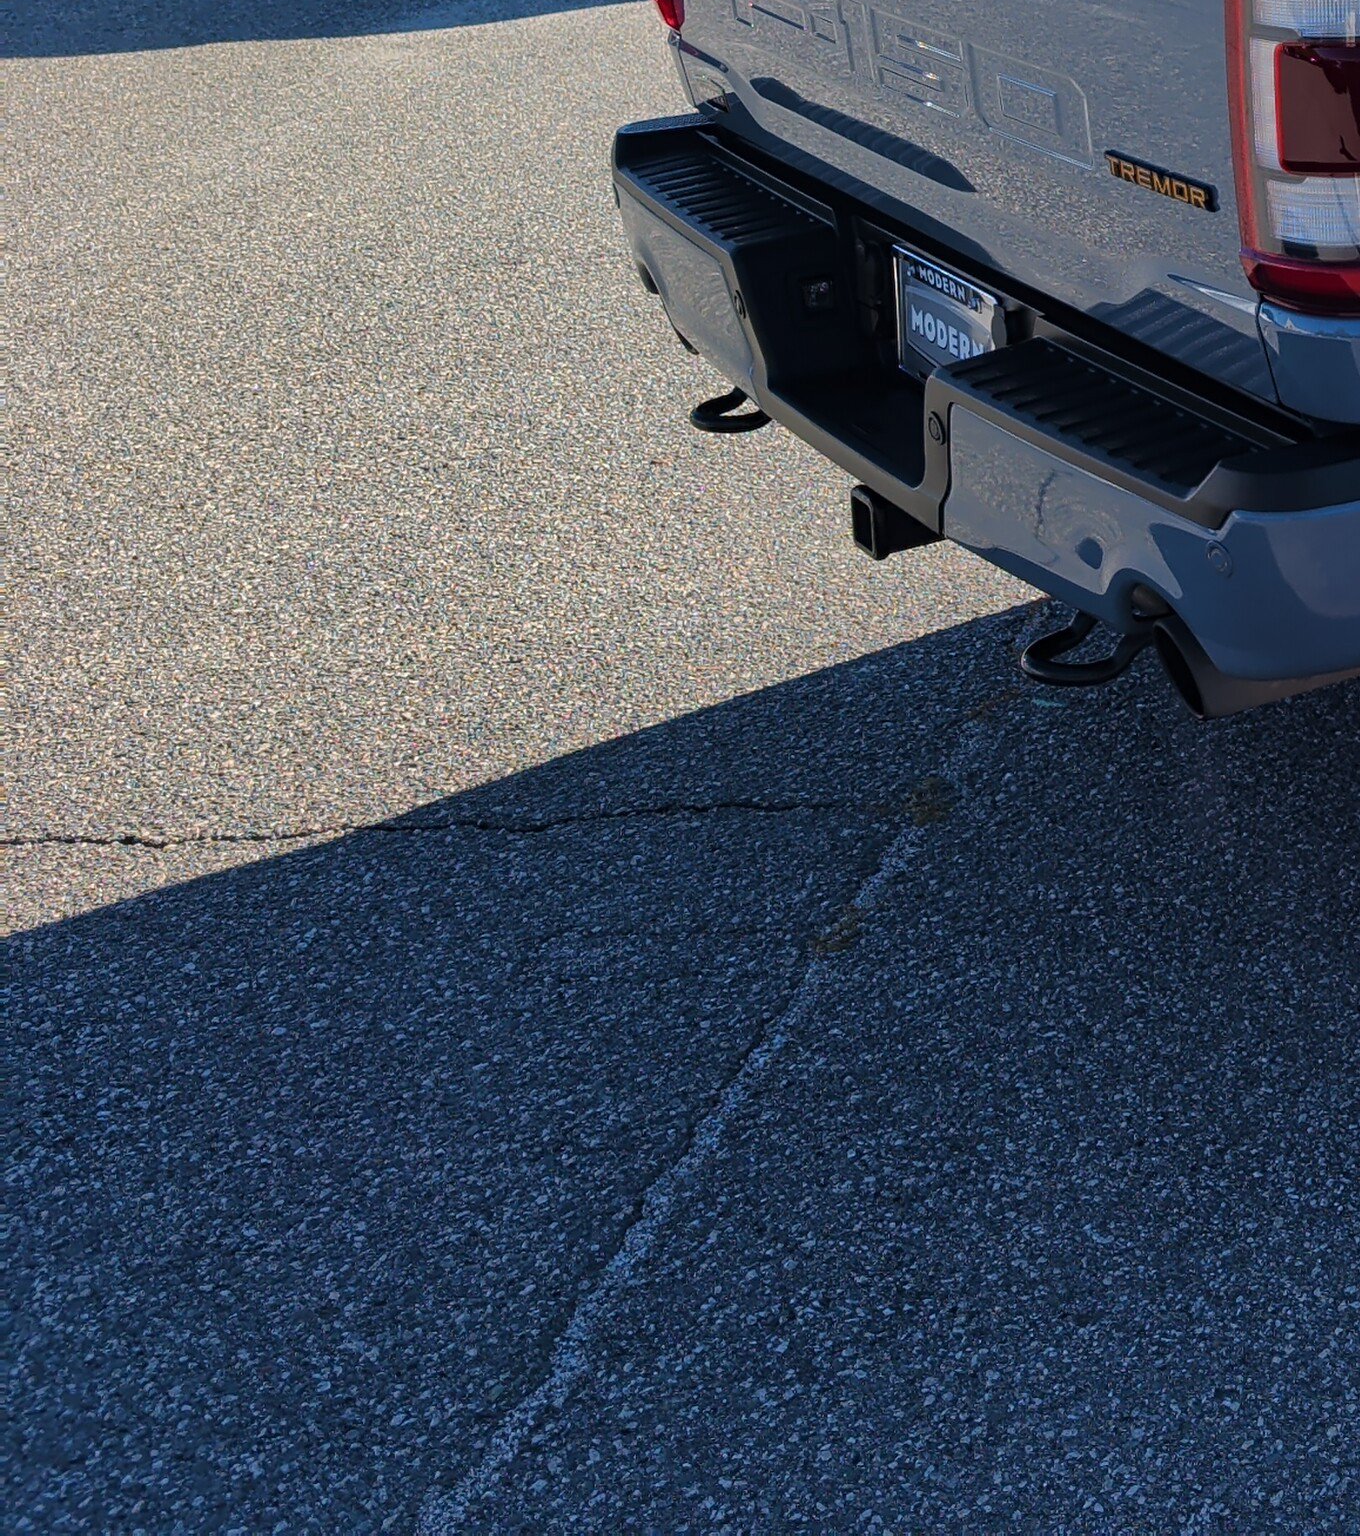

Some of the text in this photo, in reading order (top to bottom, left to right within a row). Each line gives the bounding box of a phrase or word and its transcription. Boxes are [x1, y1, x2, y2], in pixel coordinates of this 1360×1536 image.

[1104, 153, 1208, 210] TREMOR
[918, 265, 966, 301] MODERN
[911, 304, 985, 360] MODERN
